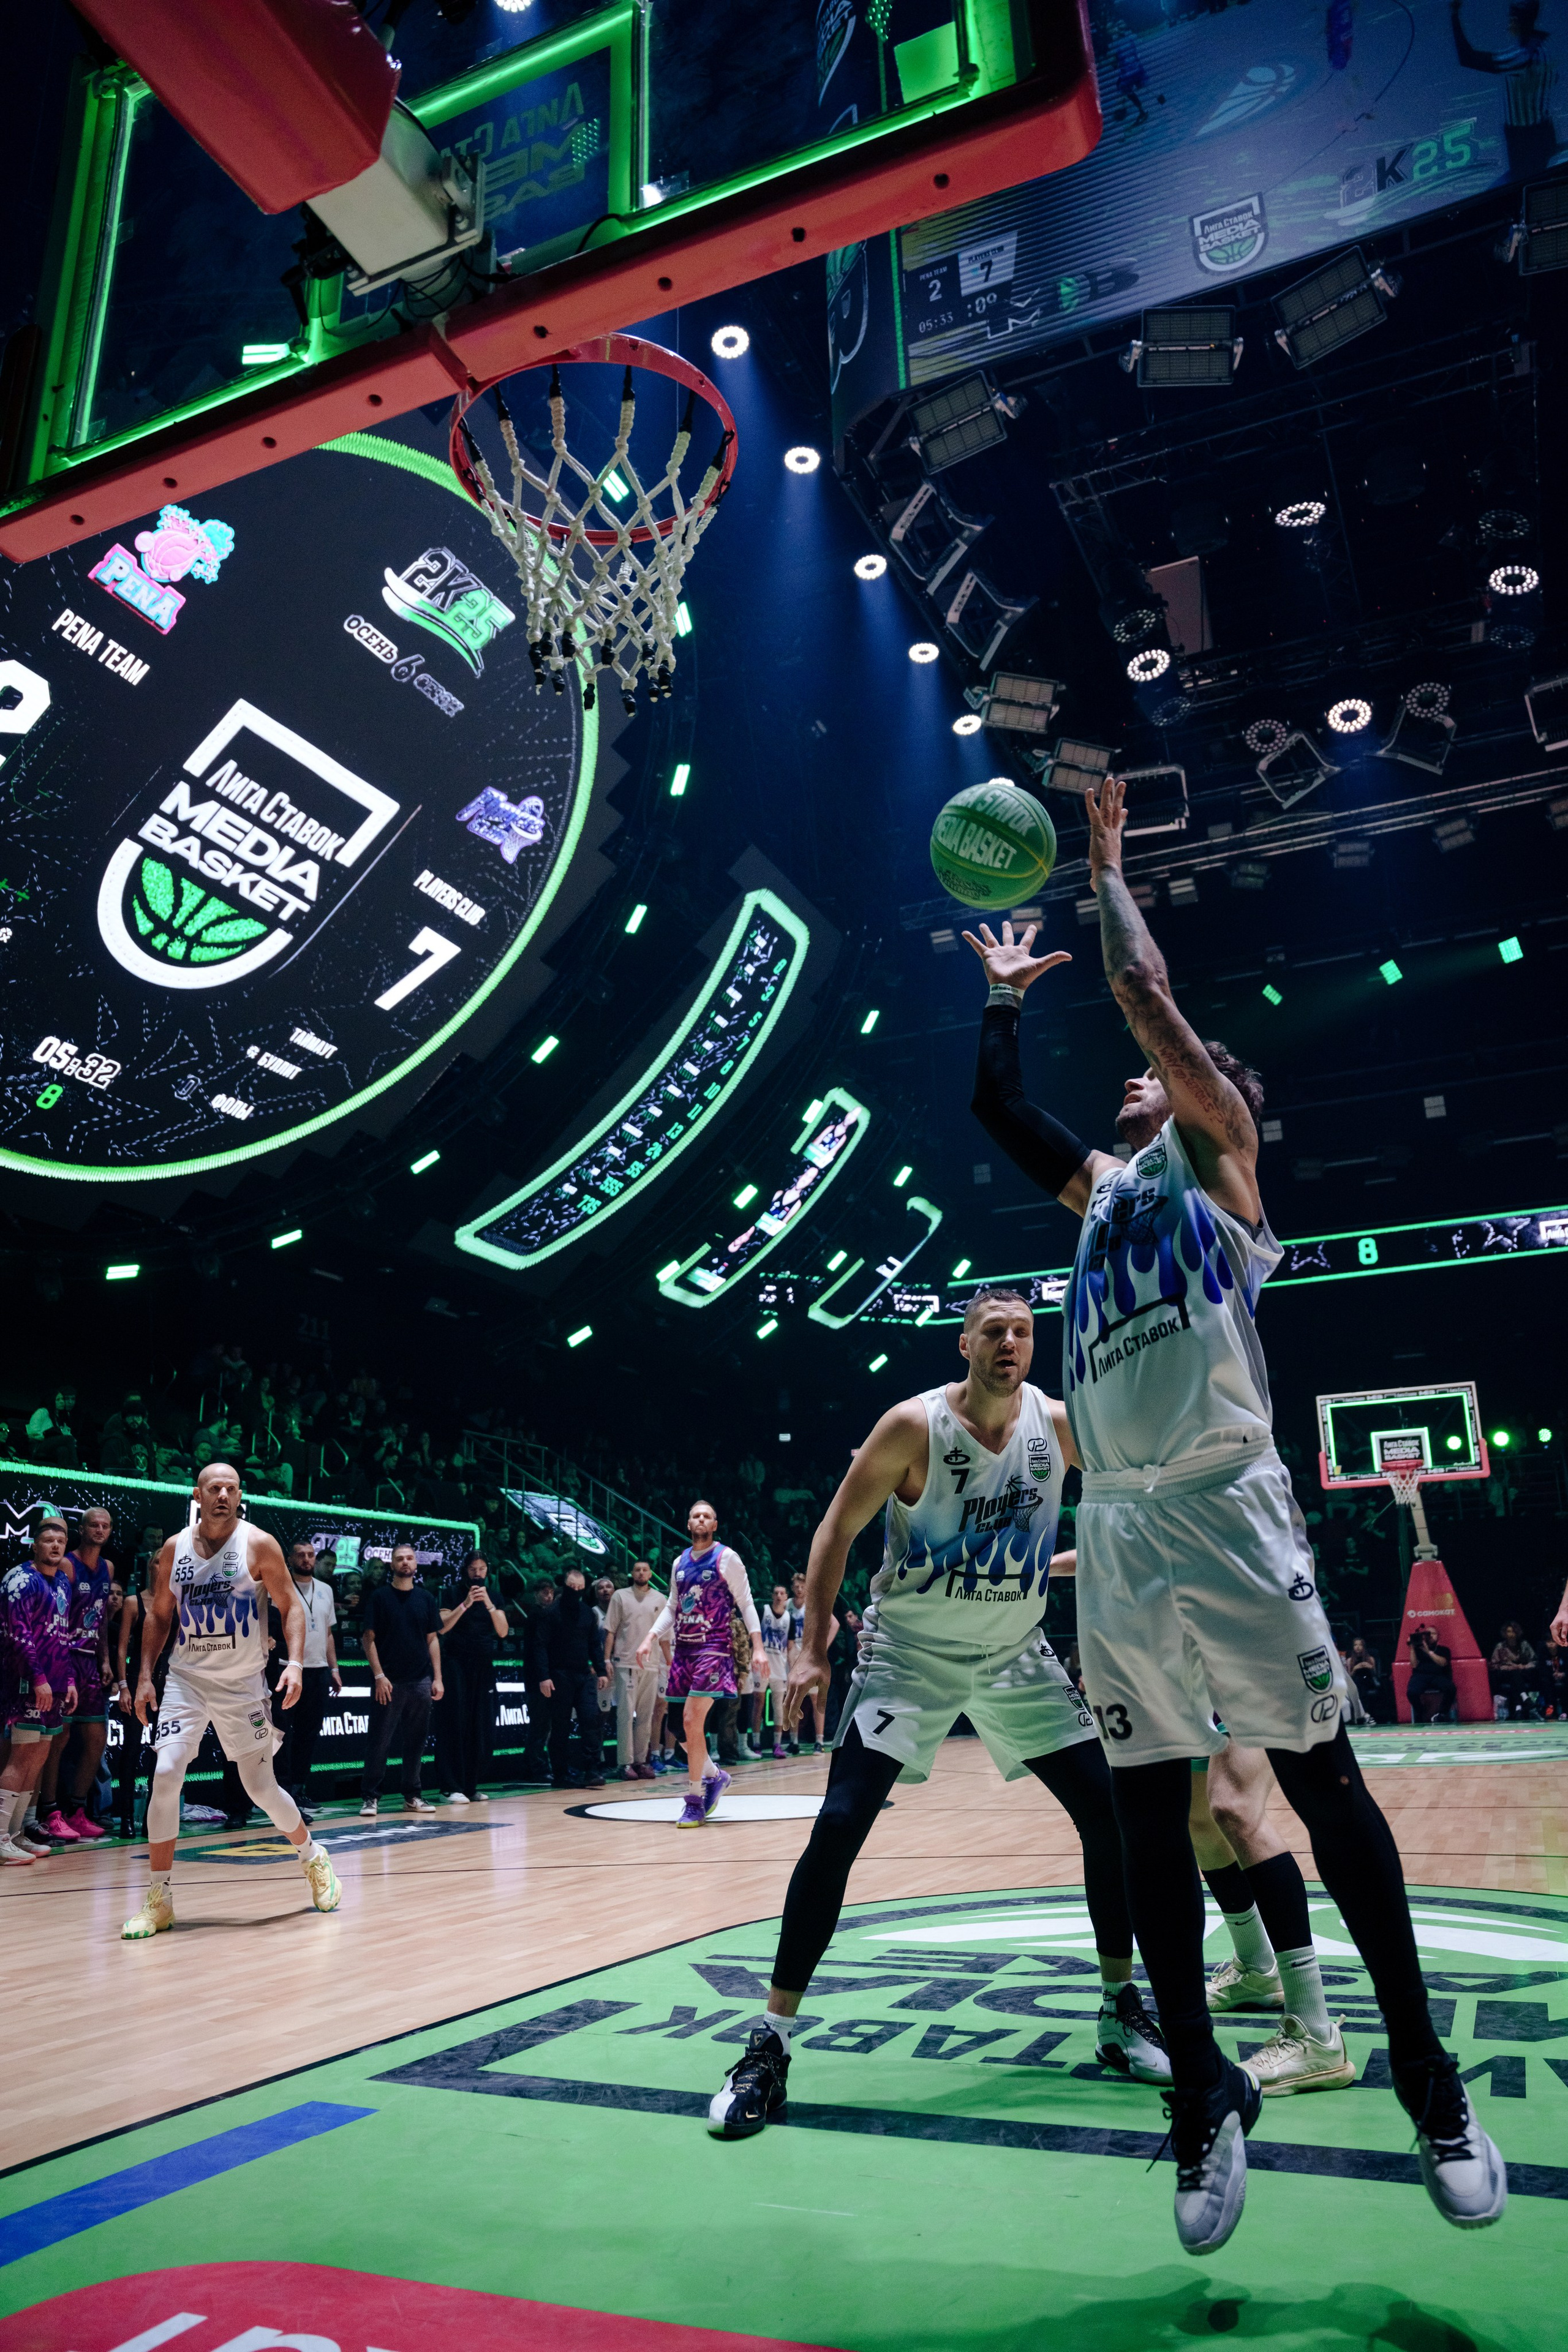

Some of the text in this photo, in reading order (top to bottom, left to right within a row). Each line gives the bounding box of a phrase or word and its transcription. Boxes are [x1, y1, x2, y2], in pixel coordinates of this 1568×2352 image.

[1199, 219, 1261, 245] MEDIA
[980, 259, 993, 282] 7
[928, 279, 943, 302] 2
[95, 551, 180, 630] PENA
[399, 546, 516, 652] 2K25
[51, 608, 151, 686] PENA TEAM
[344, 614, 398, 663] ОСЕНЬ
[390, 654, 425, 682] 6
[159, 780, 320, 902] MEDIA
[958, 822, 1018, 869] BASKET
[138, 813, 311, 921] BASKET
[413, 869, 486, 926] PLAYERS CLUB
[374, 925, 462, 1011] 7
[761, 986, 775, 1001] 3
[748, 1011, 763, 1028] 5
[289, 1027, 338, 1060] ТАЙМАУТ
[736, 1035, 750, 1052] 7
[32, 1036, 121, 1090] 05:32
[720, 1060, 734, 1075] 8
[36, 1084, 64, 1110] 8
[703, 1082, 721, 1100] 10
[211, 1093, 255, 1121] ФОЛЫ
[687, 1103, 703, 1120] 11
[666, 1121, 684, 1139] 13
[646, 1141, 663, 1159] 24
[625, 1160, 645, 1178] 55
[599, 1176, 624, 1196] 555
[576, 1194, 601, 1215] 735
[1358, 1237, 1378, 1265] 8
[1384, 1446, 1420, 1455] MEDIA
[951, 1468, 970, 1494] 7
[958, 1487, 1038, 1532] Players
[364, 1545, 394, 1562] ОСЕН
[175, 1566, 194, 1583] 555
[181, 1580, 232, 1605] Players
[320, 1716, 344, 1736] ИГА
[872, 1710, 895, 1735] 7
[1093, 1703, 1133, 1740] 13
